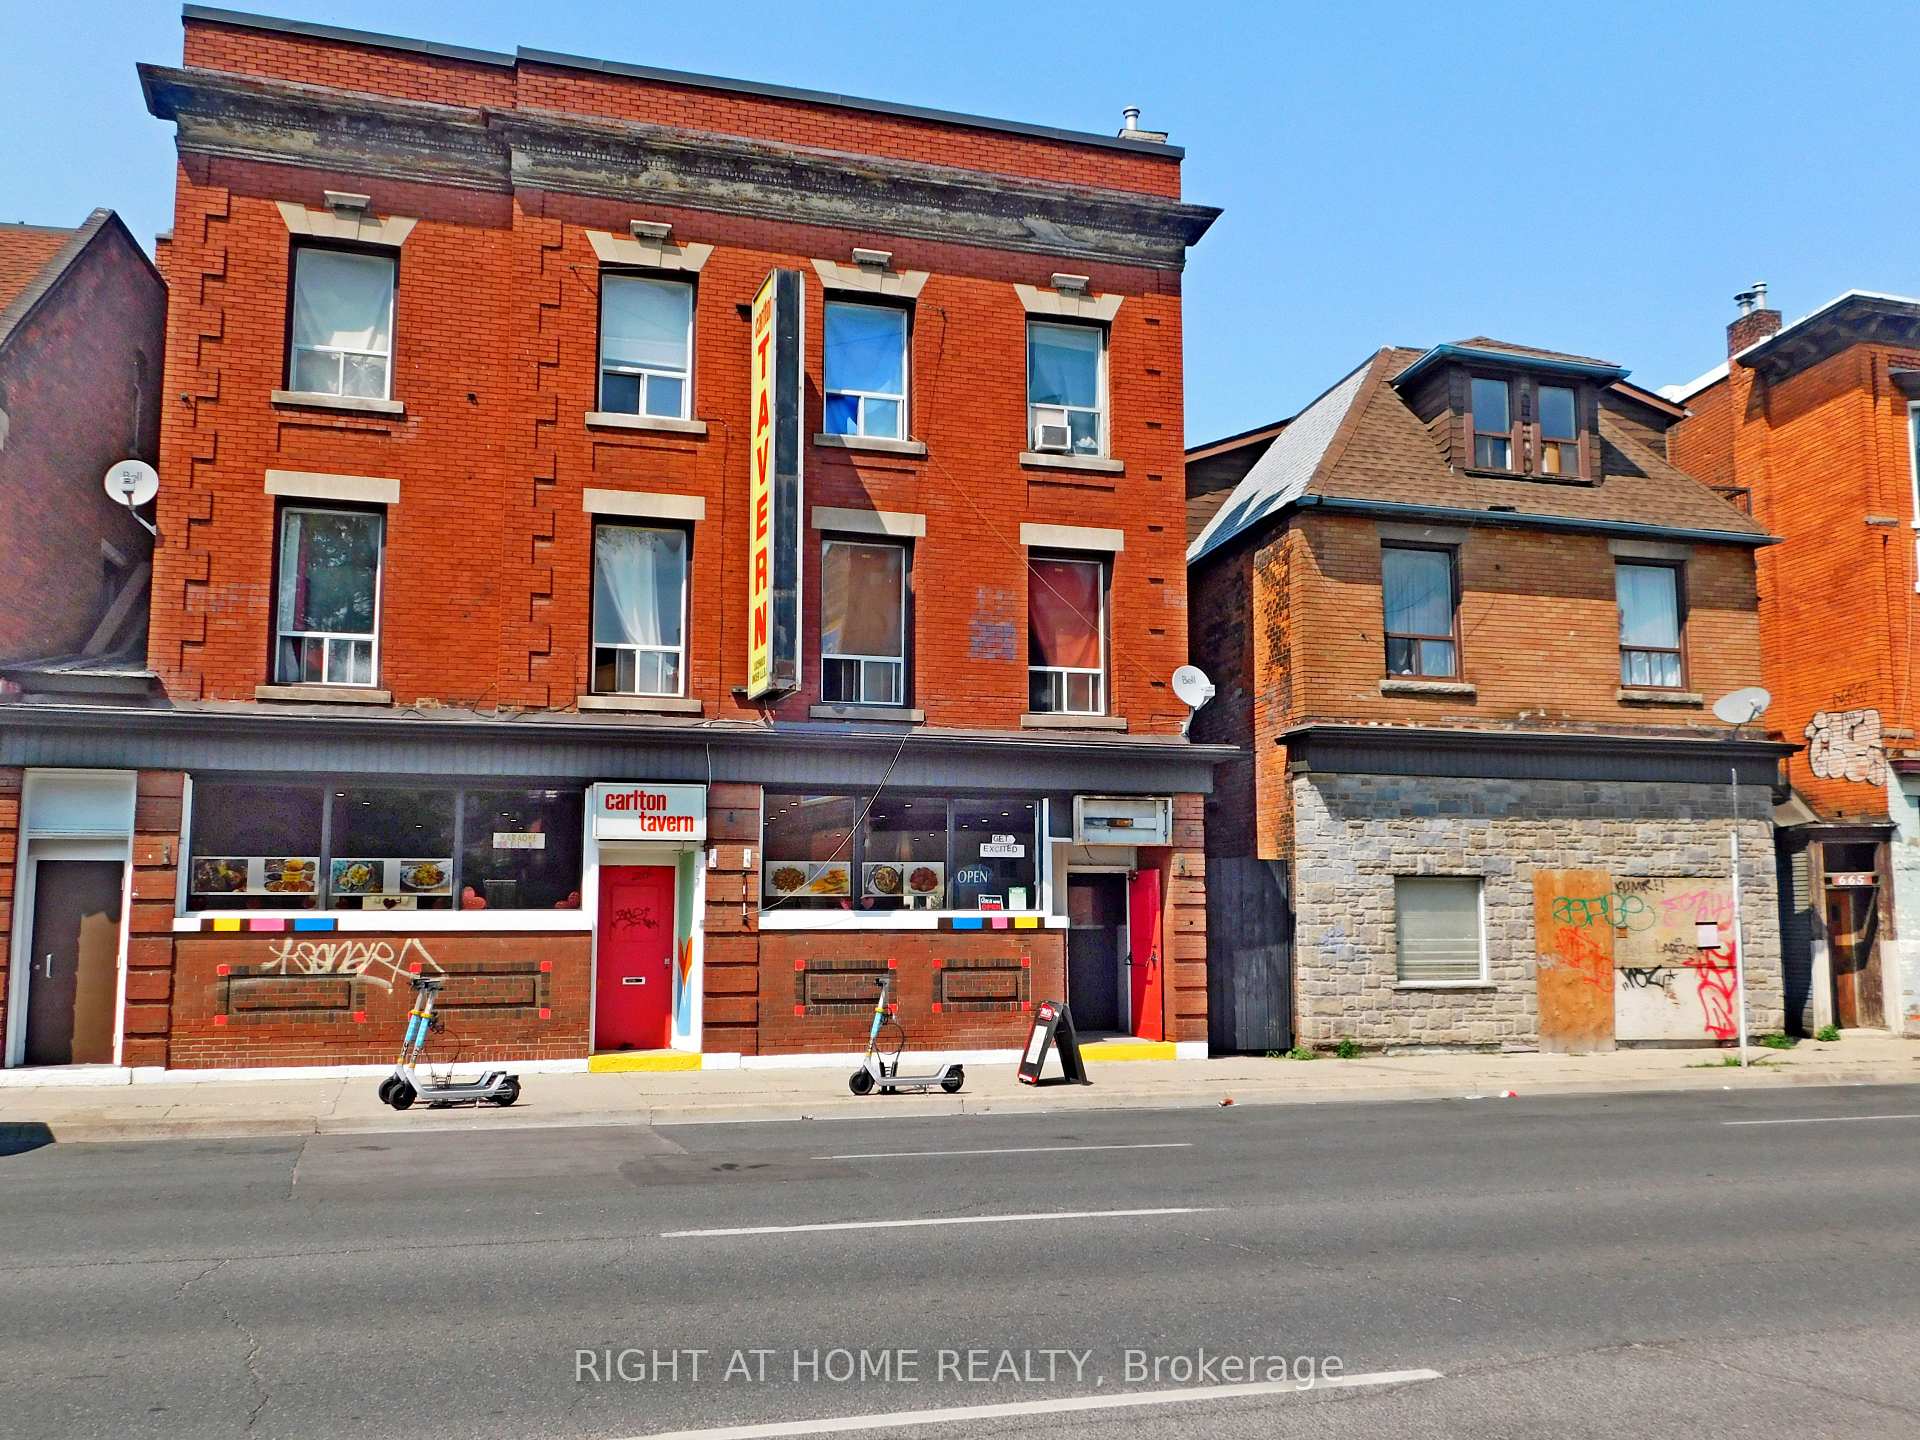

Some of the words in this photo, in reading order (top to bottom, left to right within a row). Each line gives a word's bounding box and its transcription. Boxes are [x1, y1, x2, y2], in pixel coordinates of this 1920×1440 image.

[754, 331, 770, 650] TAVERN
[605, 790, 666, 811] carlton
[639, 811, 694, 832] tavern
[983, 845, 1018, 853] EXCITED
[957, 870, 988, 884] OPEN
[1838, 875, 1865, 886] 665
